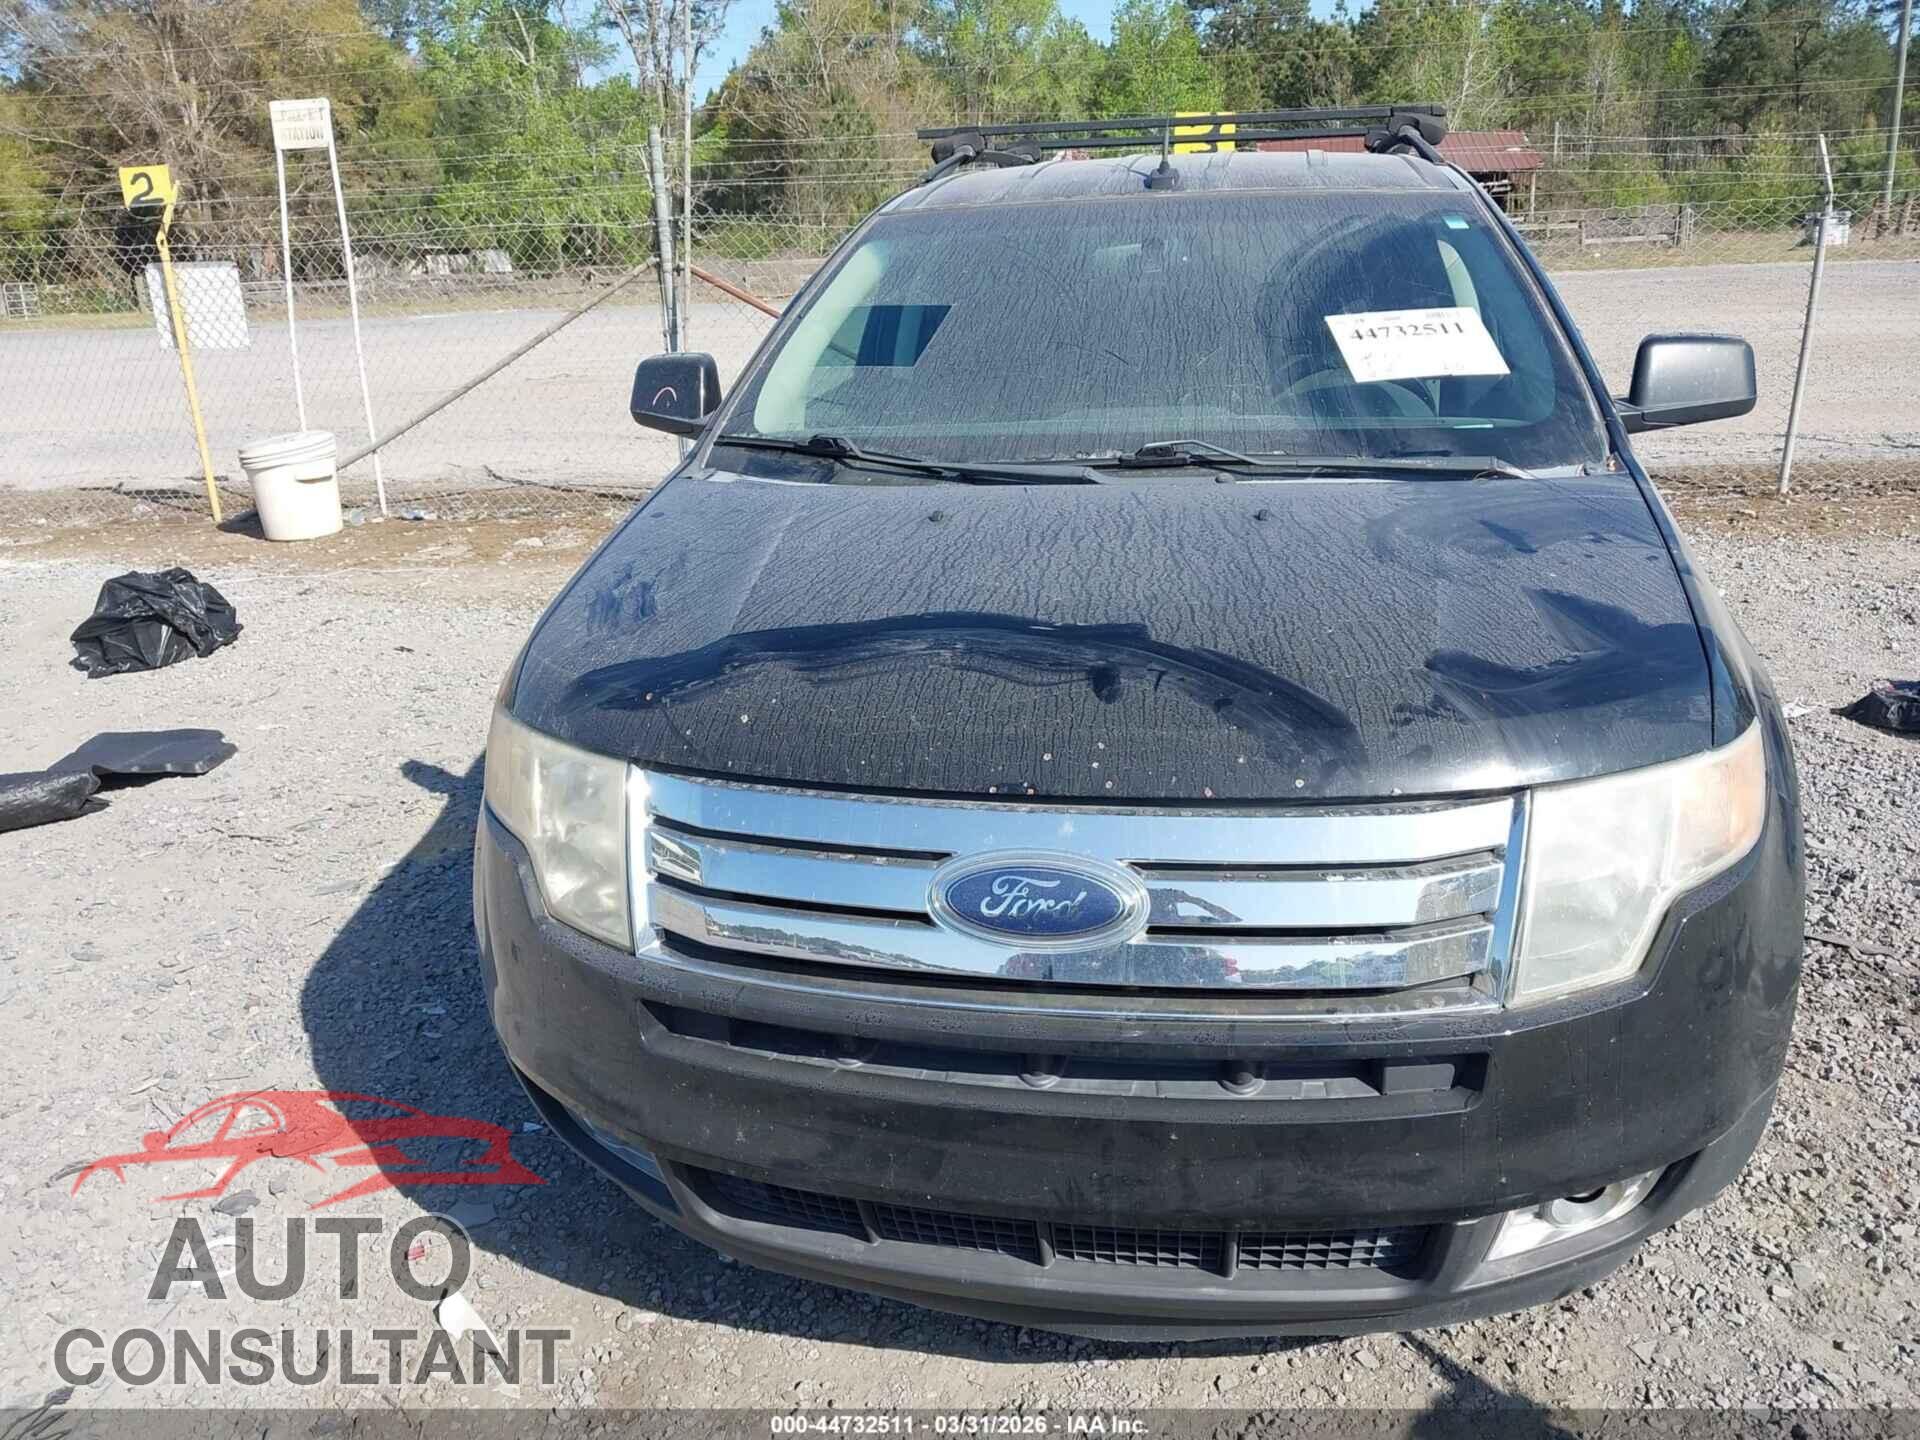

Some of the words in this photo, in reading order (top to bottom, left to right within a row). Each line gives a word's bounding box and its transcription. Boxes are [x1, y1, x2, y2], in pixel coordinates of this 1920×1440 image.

[129, 171, 165, 205] 2
[1350, 322, 1464, 341] 44732511
[980, 875, 1088, 920] Ford
